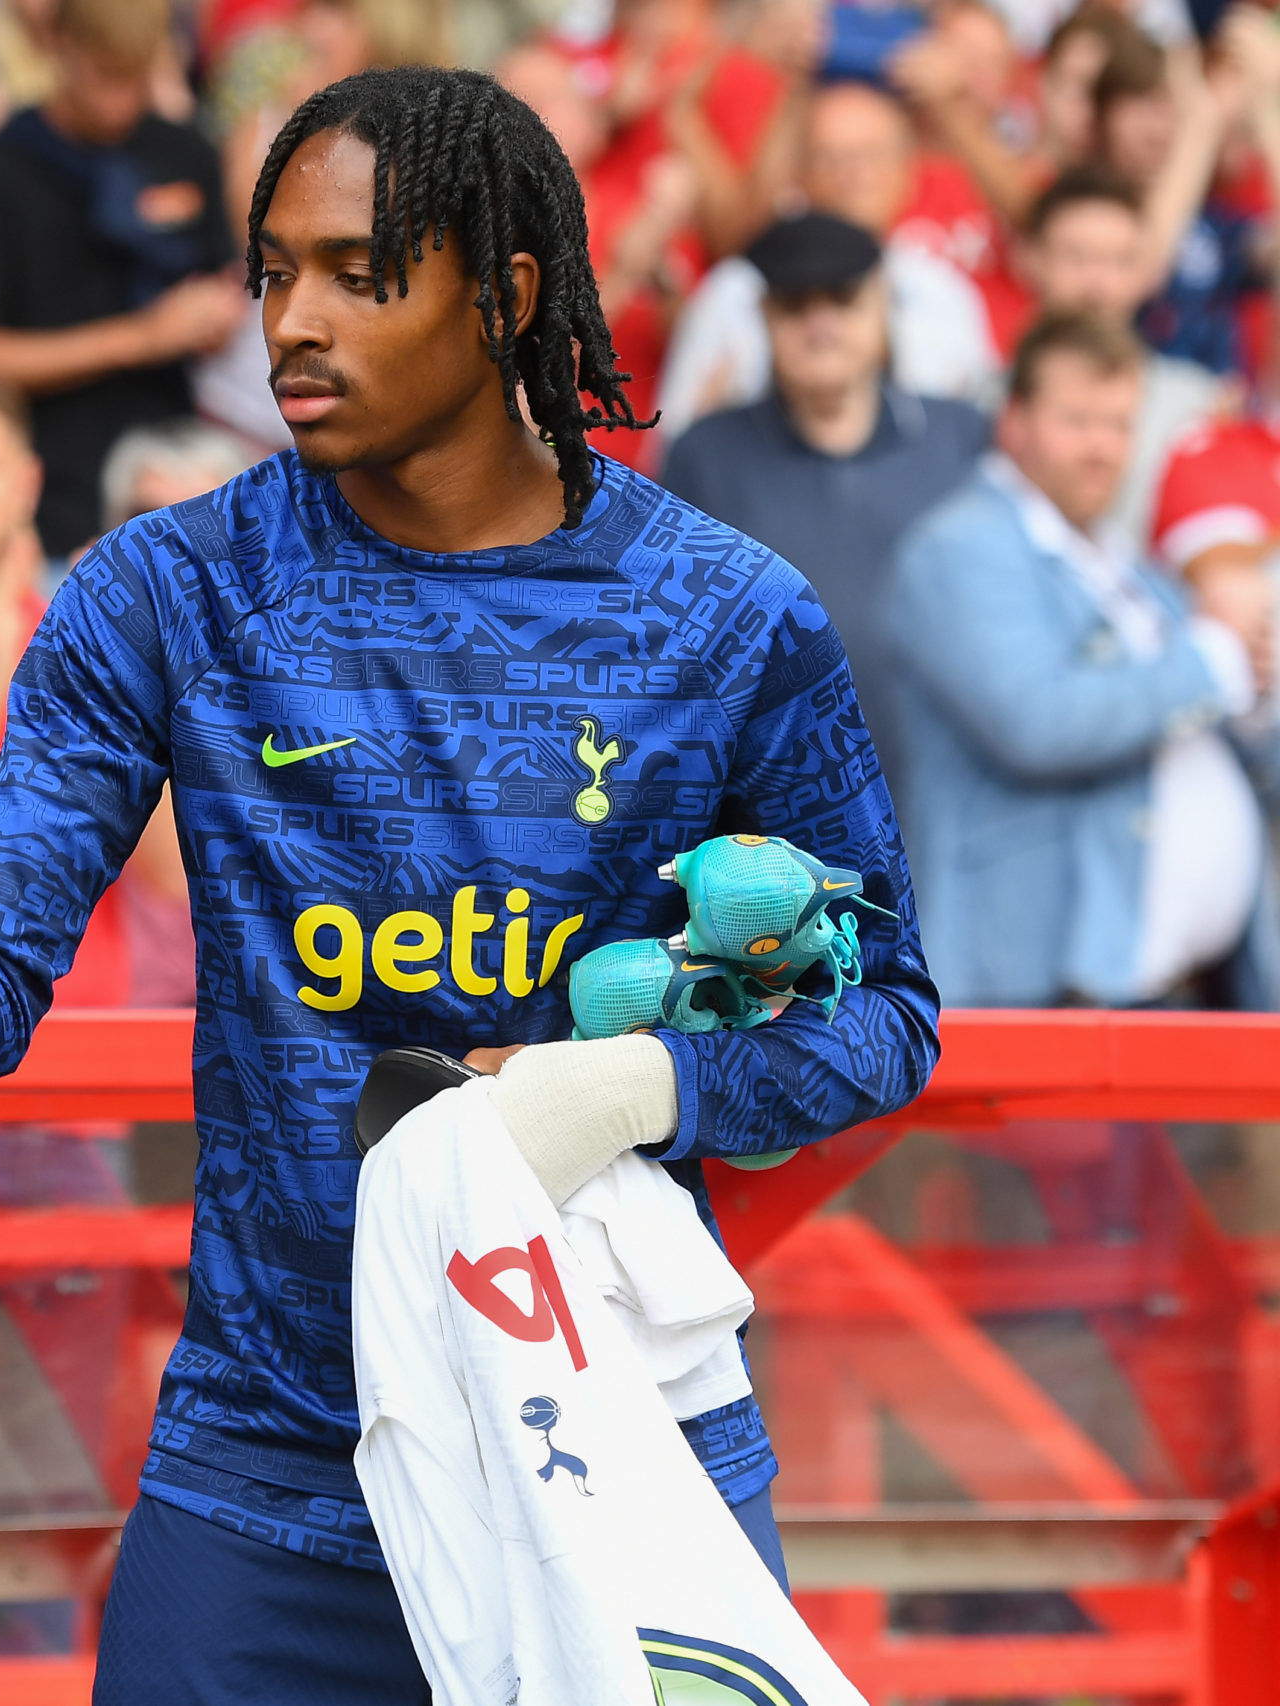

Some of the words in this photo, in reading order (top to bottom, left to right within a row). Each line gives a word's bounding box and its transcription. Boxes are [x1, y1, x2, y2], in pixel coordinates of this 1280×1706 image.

[176, 500, 233, 562] URS
[592, 484, 658, 549] URS
[76, 554, 135, 617] URS
[294, 575, 416, 606] PURS
[419, 578, 594, 613] SPURS
[237, 645, 332, 684] URS
[335, 653, 502, 689] SPURS
[504, 661, 679, 694] SPURS
[249, 686, 416, 725] SPURS
[417, 696, 588, 731] SPURS
[591, 704, 736, 736] SPUR
[332, 773, 500, 811] SPURS
[501, 781, 670, 817] SPRS
[756, 741, 881, 829] SPURS
[245, 804, 415, 847] SPURS
[417, 818, 586, 855] SPURS
[588, 825, 705, 856] SPUR
[19, 882, 89, 937] SPU
[204, 877, 326, 920] PURS
[293, 885, 584, 1012] getir
[260, 1043, 374, 1074] SPUR
